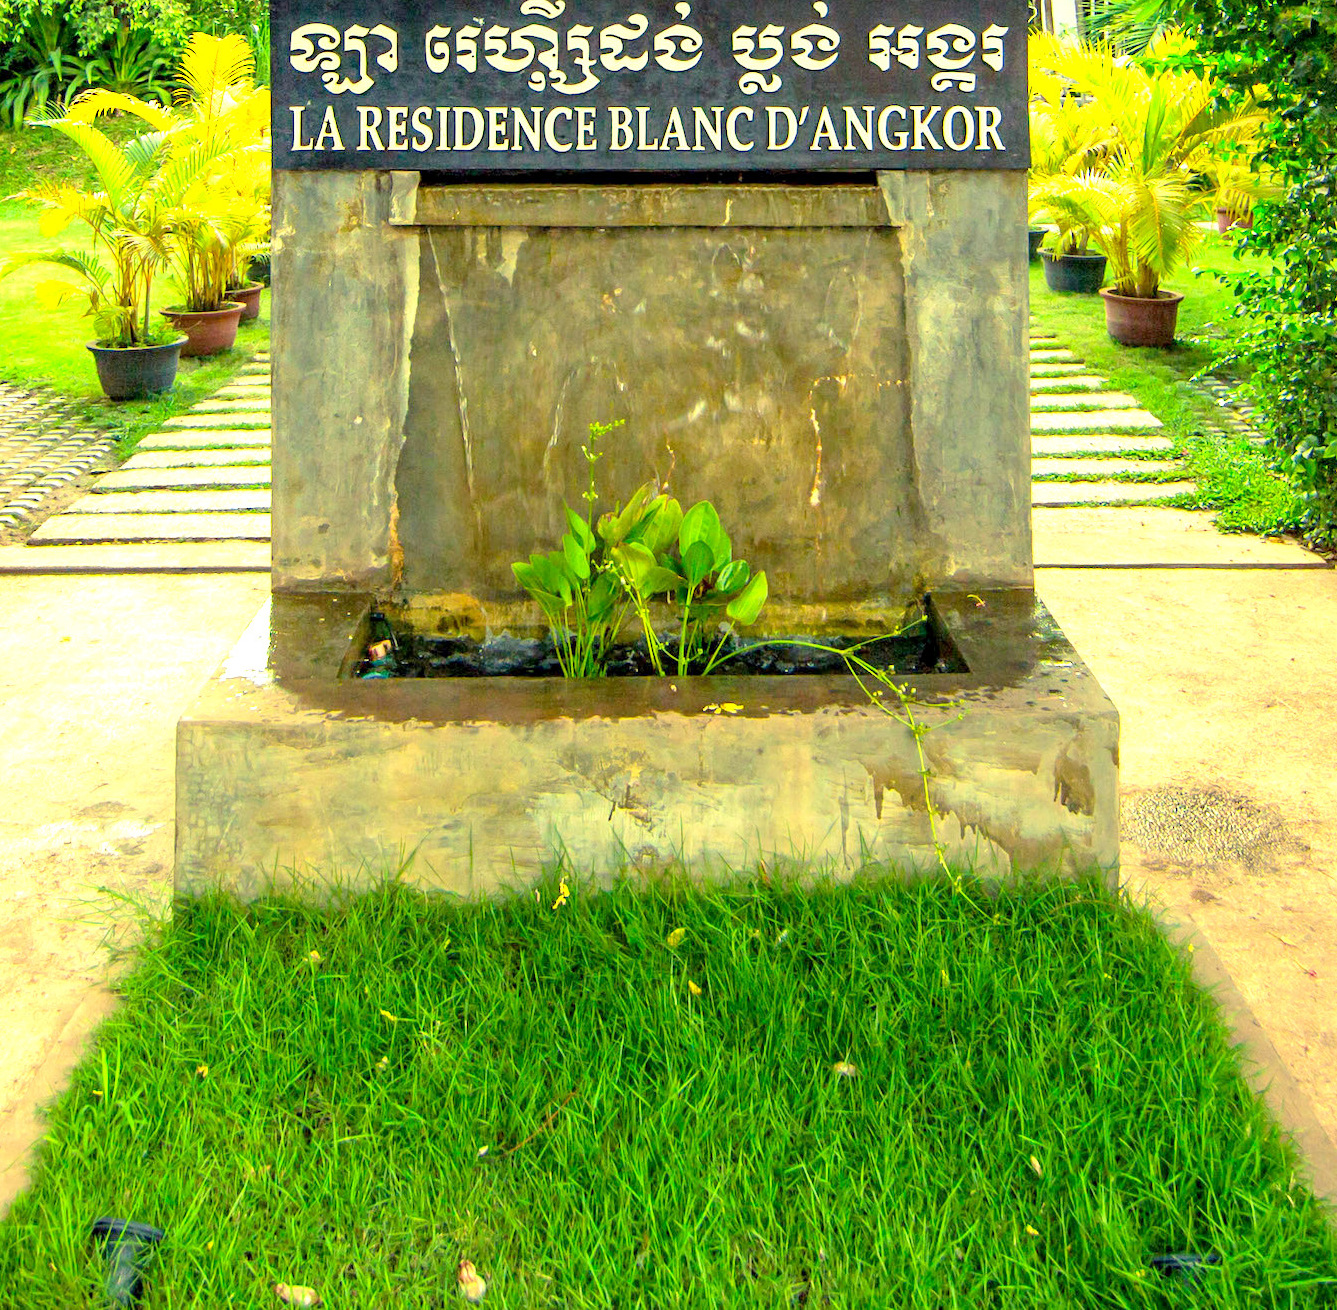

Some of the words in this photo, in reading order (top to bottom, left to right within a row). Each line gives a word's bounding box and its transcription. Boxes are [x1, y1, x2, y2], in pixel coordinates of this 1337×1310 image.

[289, 23, 398, 95] ឡា
[731, 0, 841, 95] ប្លង់
[868, 23, 1009, 93] អង្គរ
[289, 105, 346, 152] LA
[356, 105, 598, 153] RESIDENCE
[607, 105, 755, 152] BLANC
[764, 105, 1007, 152] D'ANGKOR
